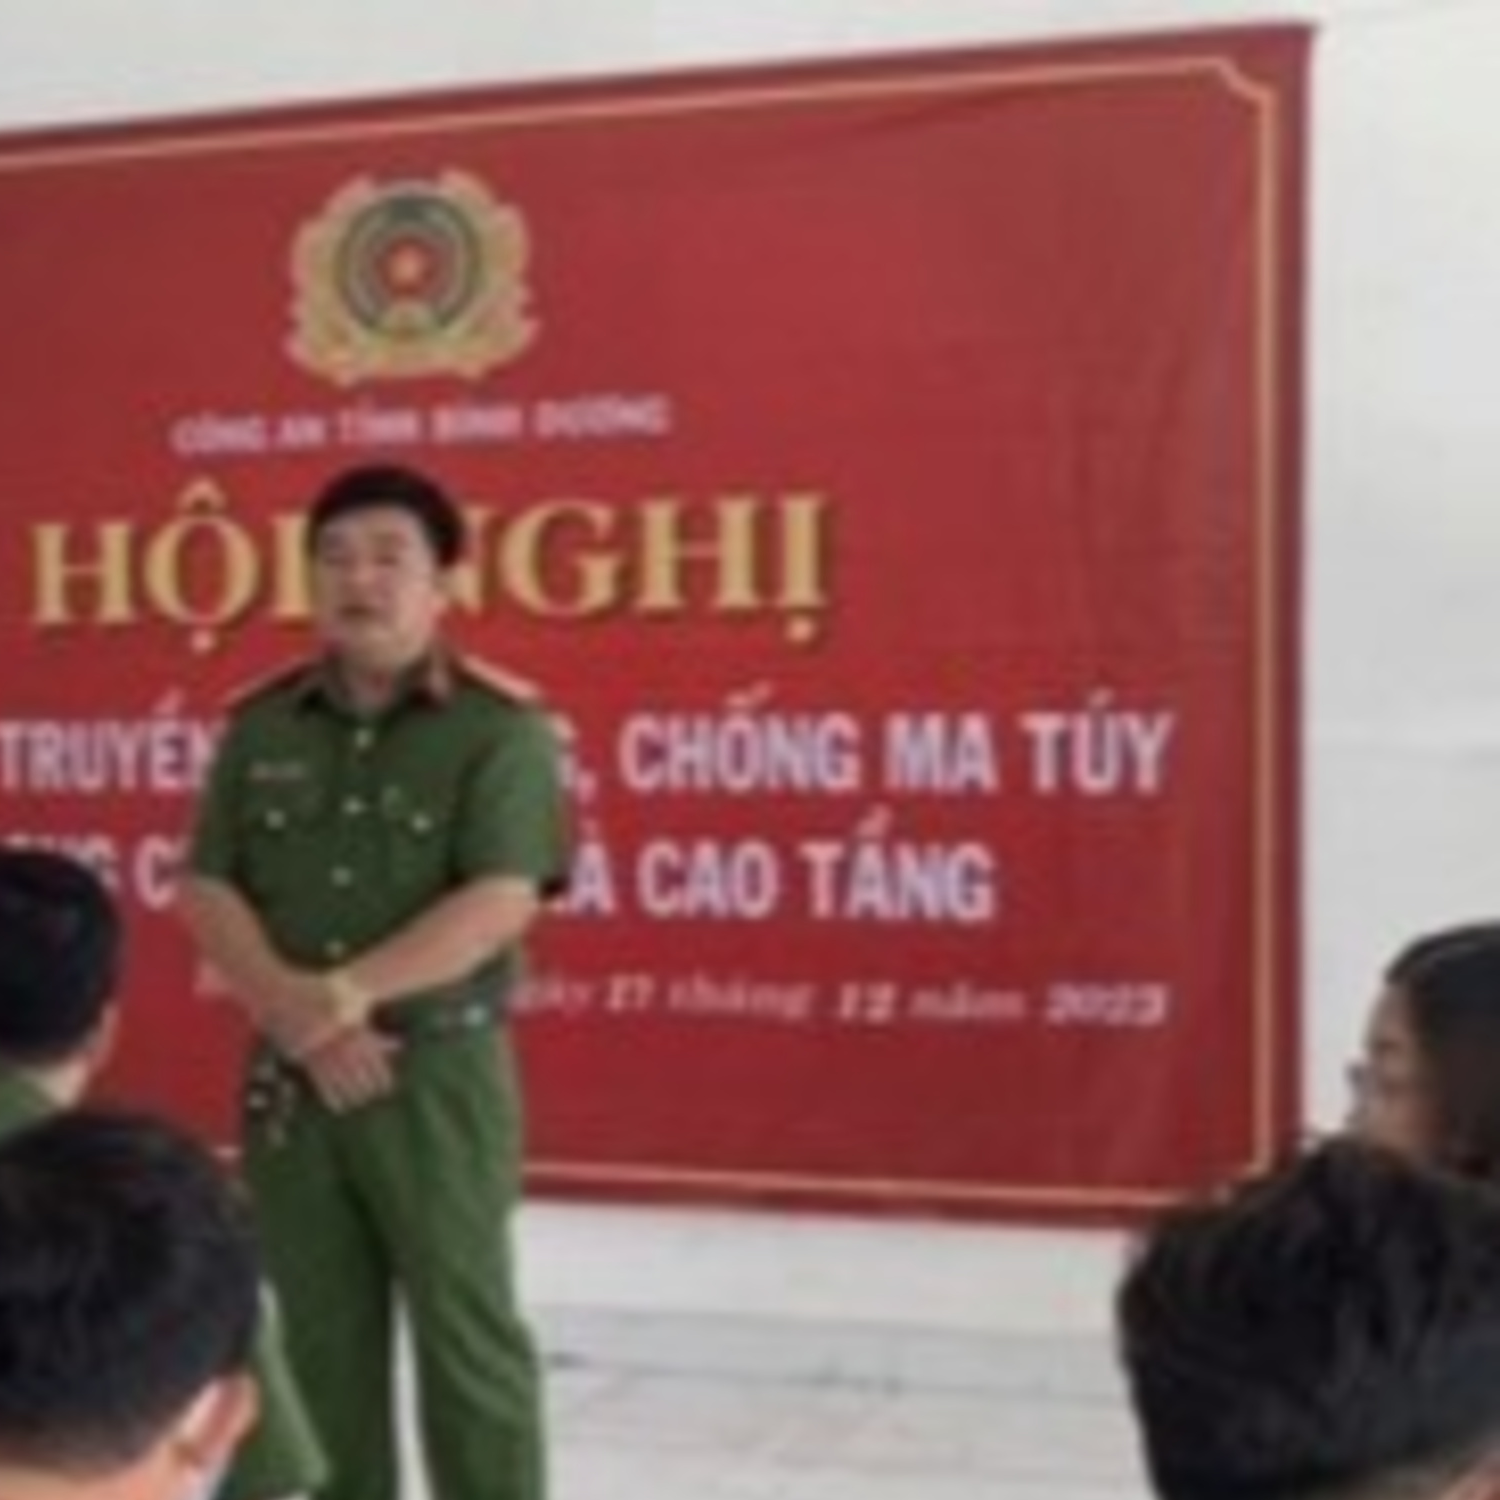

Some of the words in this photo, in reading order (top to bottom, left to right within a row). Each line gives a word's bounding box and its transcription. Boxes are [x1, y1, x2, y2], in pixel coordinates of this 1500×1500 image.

[277, 414, 326, 450] AN
[32, 476, 312, 654] HỘI
[617, 682, 861, 793] CHỐNG
[884, 713, 997, 790] MA
[1017, 690, 1172, 794] TÚY
[636, 840, 779, 920] CAO
